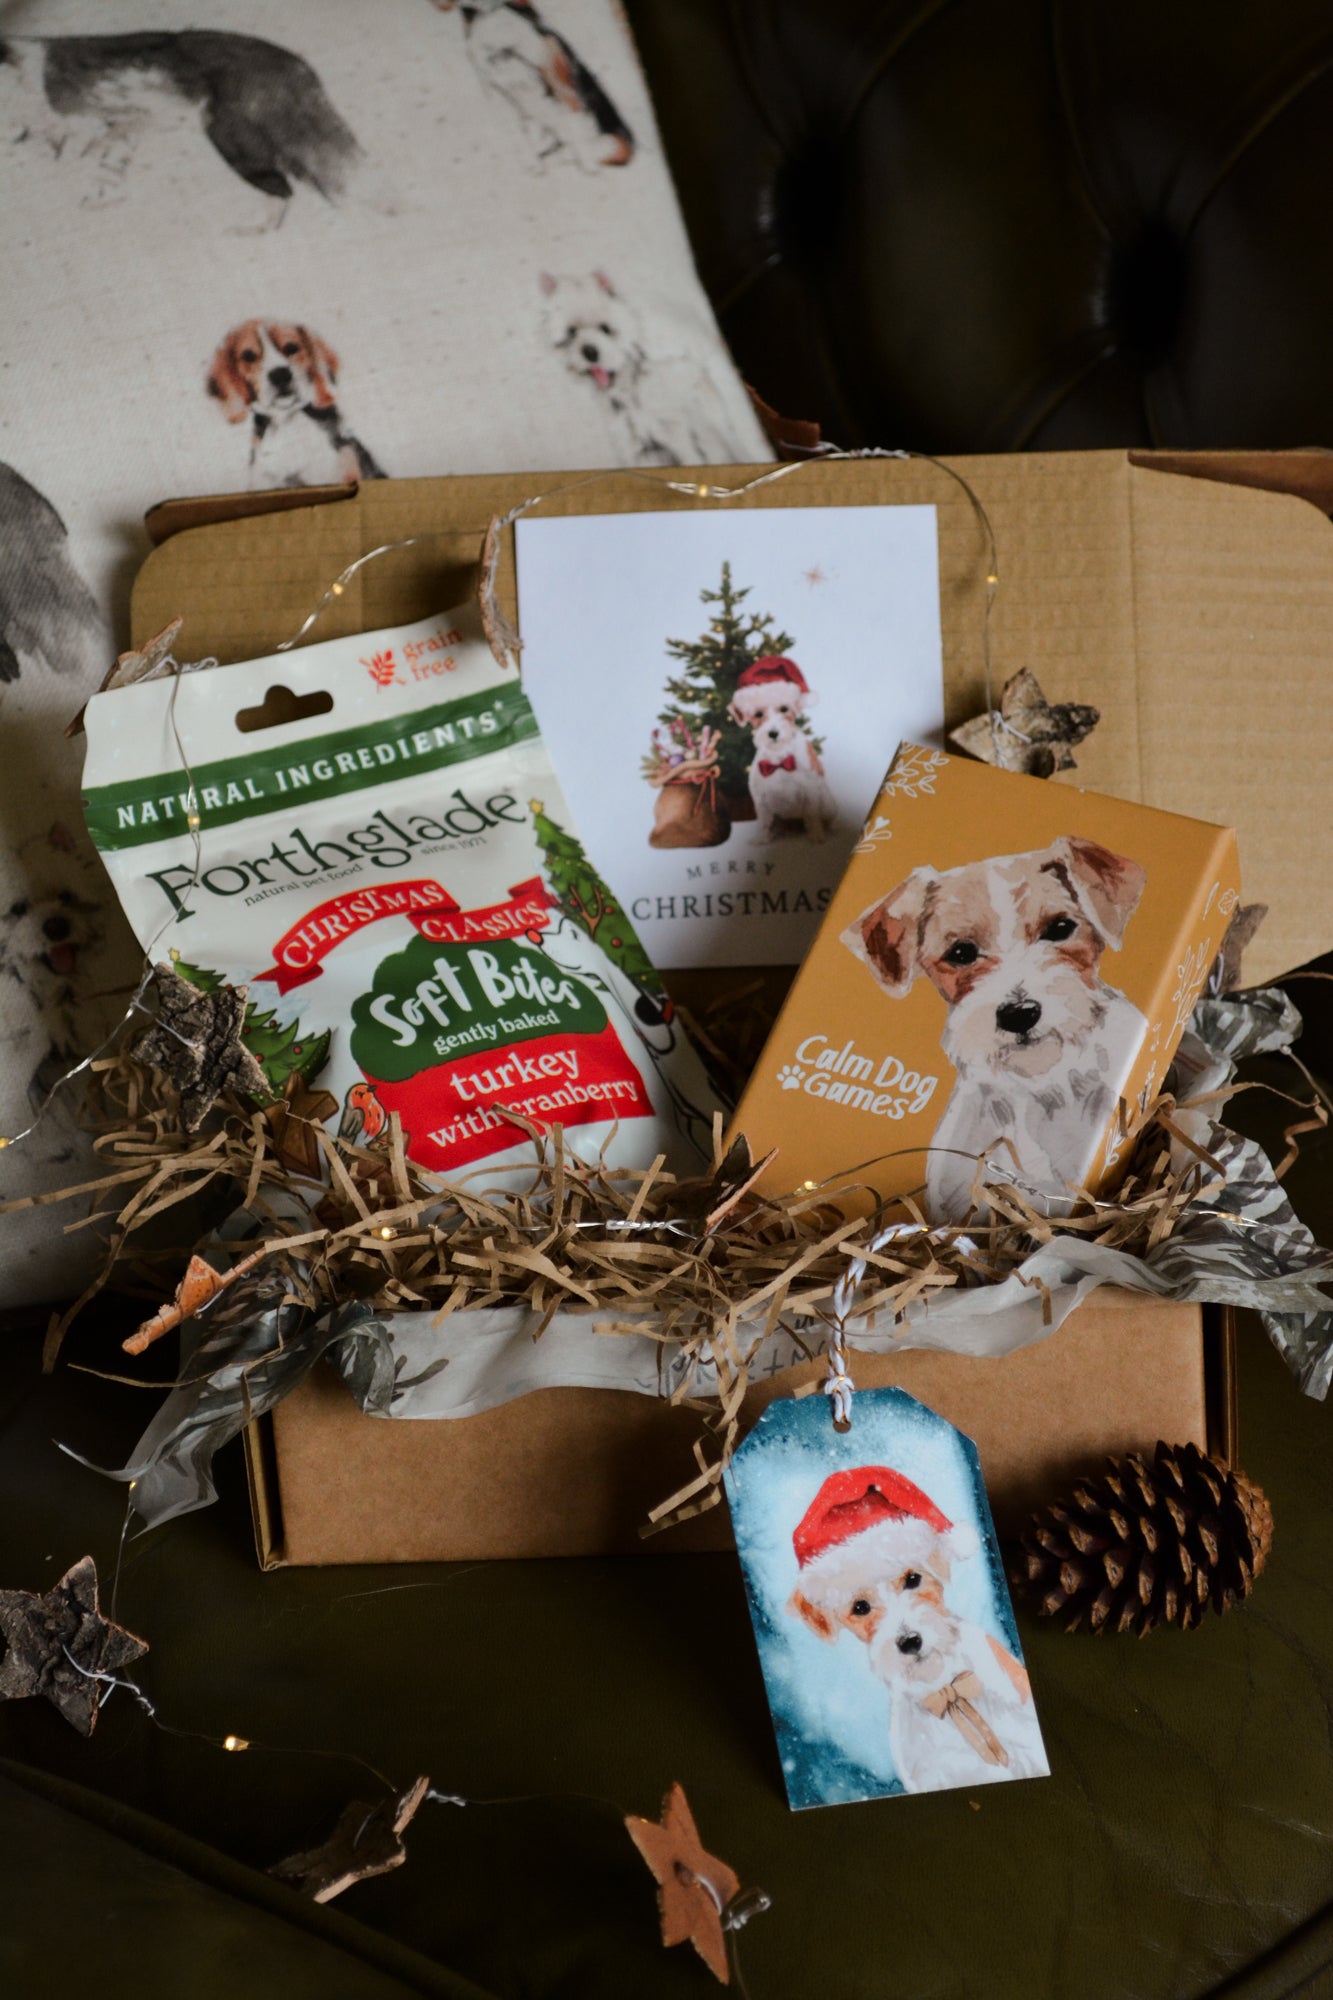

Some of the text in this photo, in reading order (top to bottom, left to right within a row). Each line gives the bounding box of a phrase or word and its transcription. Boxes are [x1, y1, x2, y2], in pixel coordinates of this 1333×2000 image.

[402, 628, 464, 662] grain
[410, 656, 458, 681] free
[116, 778, 265, 829] NATURAL
[146, 795, 526, 923] Forthglade
[421, 842, 457, 856] since
[686, 860, 775, 880] MERRY
[243, 863, 364, 907] natural pet food
[631, 887, 832, 920] CHRISTMAS
[421, 901, 549, 942] CLASSICS
[369, 949, 580, 1047] Soft Bites
[433, 1009, 561, 1055] gently baked
[449, 1048, 579, 1102] turkey
[795, 1034, 939, 1114] Calm Dog
[803, 1072, 909, 1120] Games
[427, 1080, 639, 1148] with cranberry
